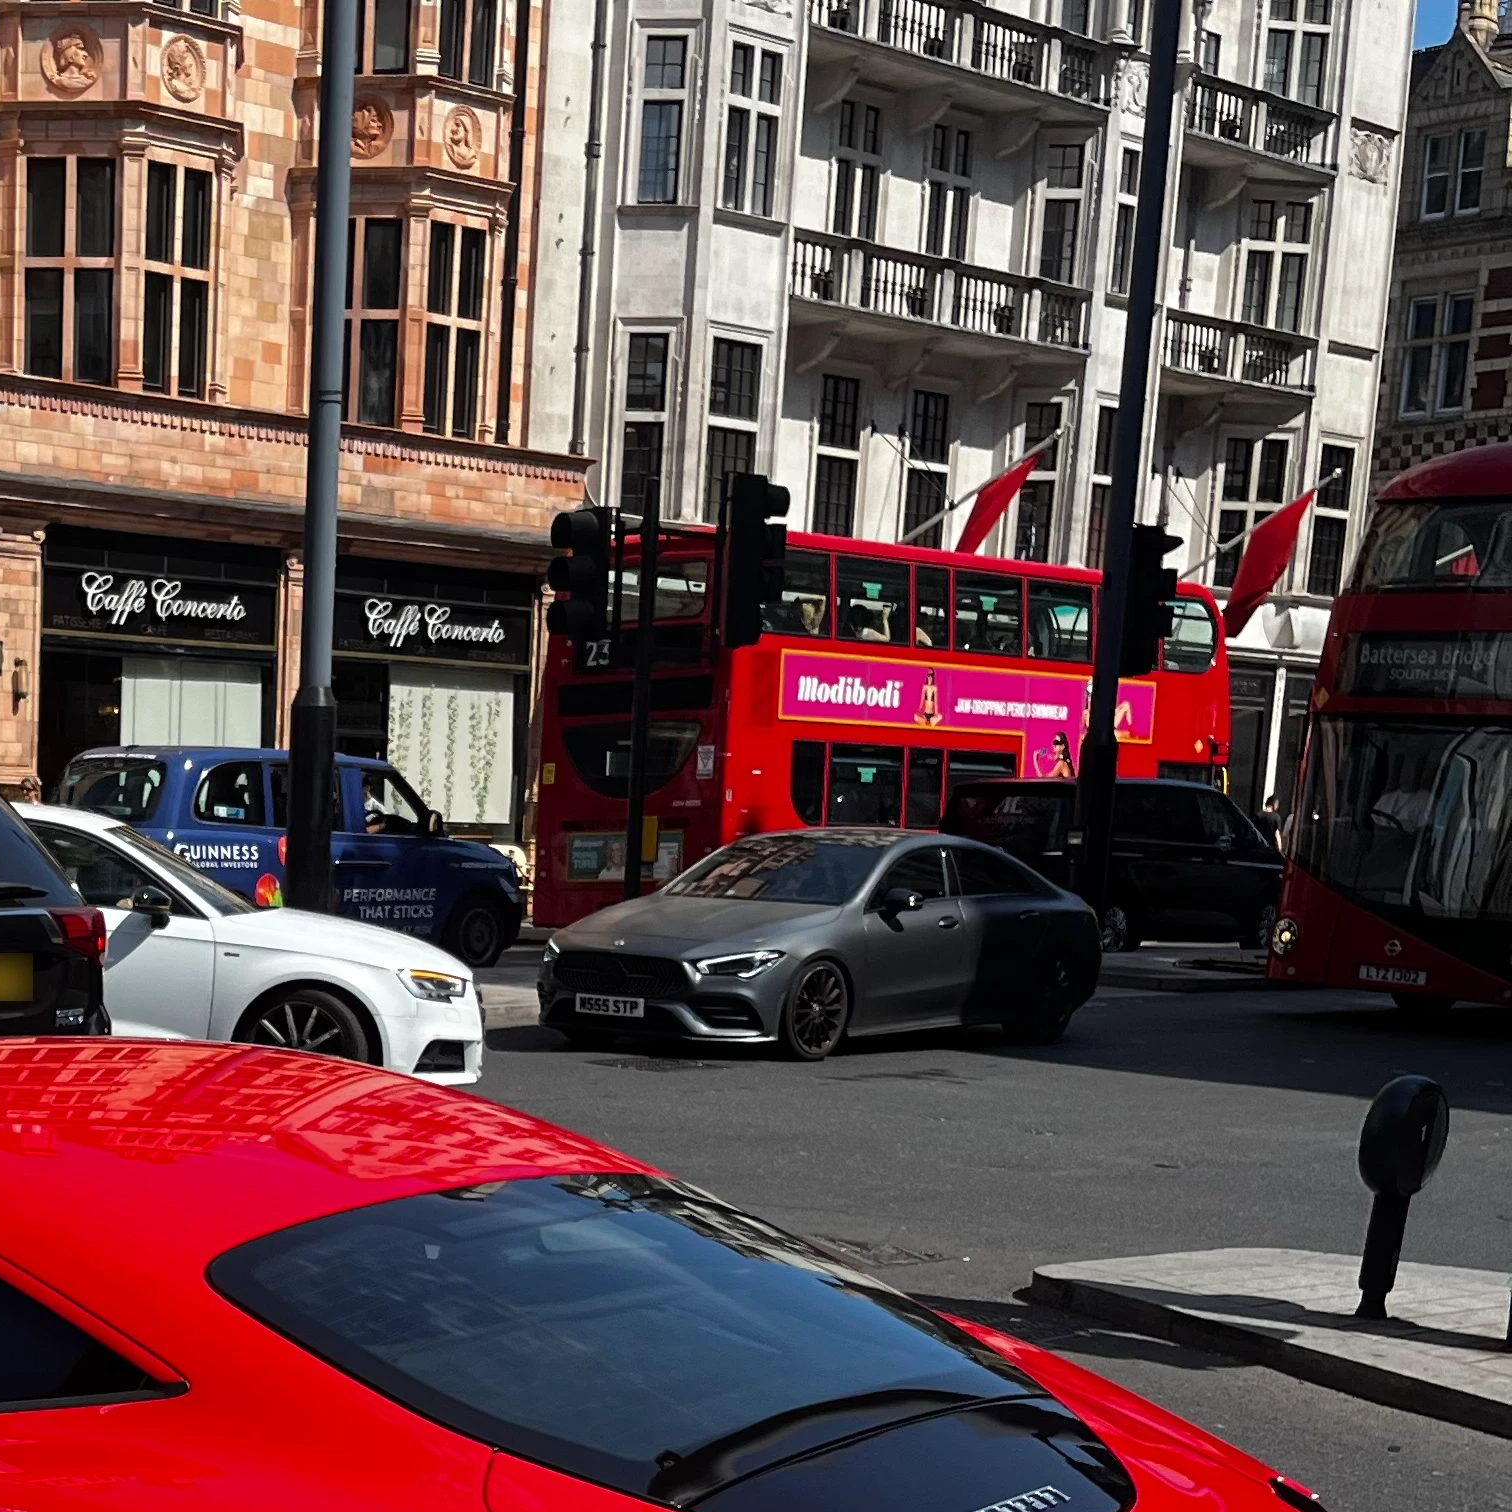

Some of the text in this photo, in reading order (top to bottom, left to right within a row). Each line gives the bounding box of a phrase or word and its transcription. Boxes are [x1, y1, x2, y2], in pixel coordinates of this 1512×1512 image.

[81, 571, 246, 625] Caffé Concerto
[425, 604, 506, 643] Concerto
[1360, 641, 1493, 671] Battersea Bridge
[1388, 667, 1429, 680] SOUTH
[797, 675, 901, 709] Modibodi
[174, 842, 259, 862] GUINNESS
[343, 888, 437, 903] PERFORMANCE
[359, 905, 434, 919] THAT STICKS
[612, 999, 638, 1015] STP
